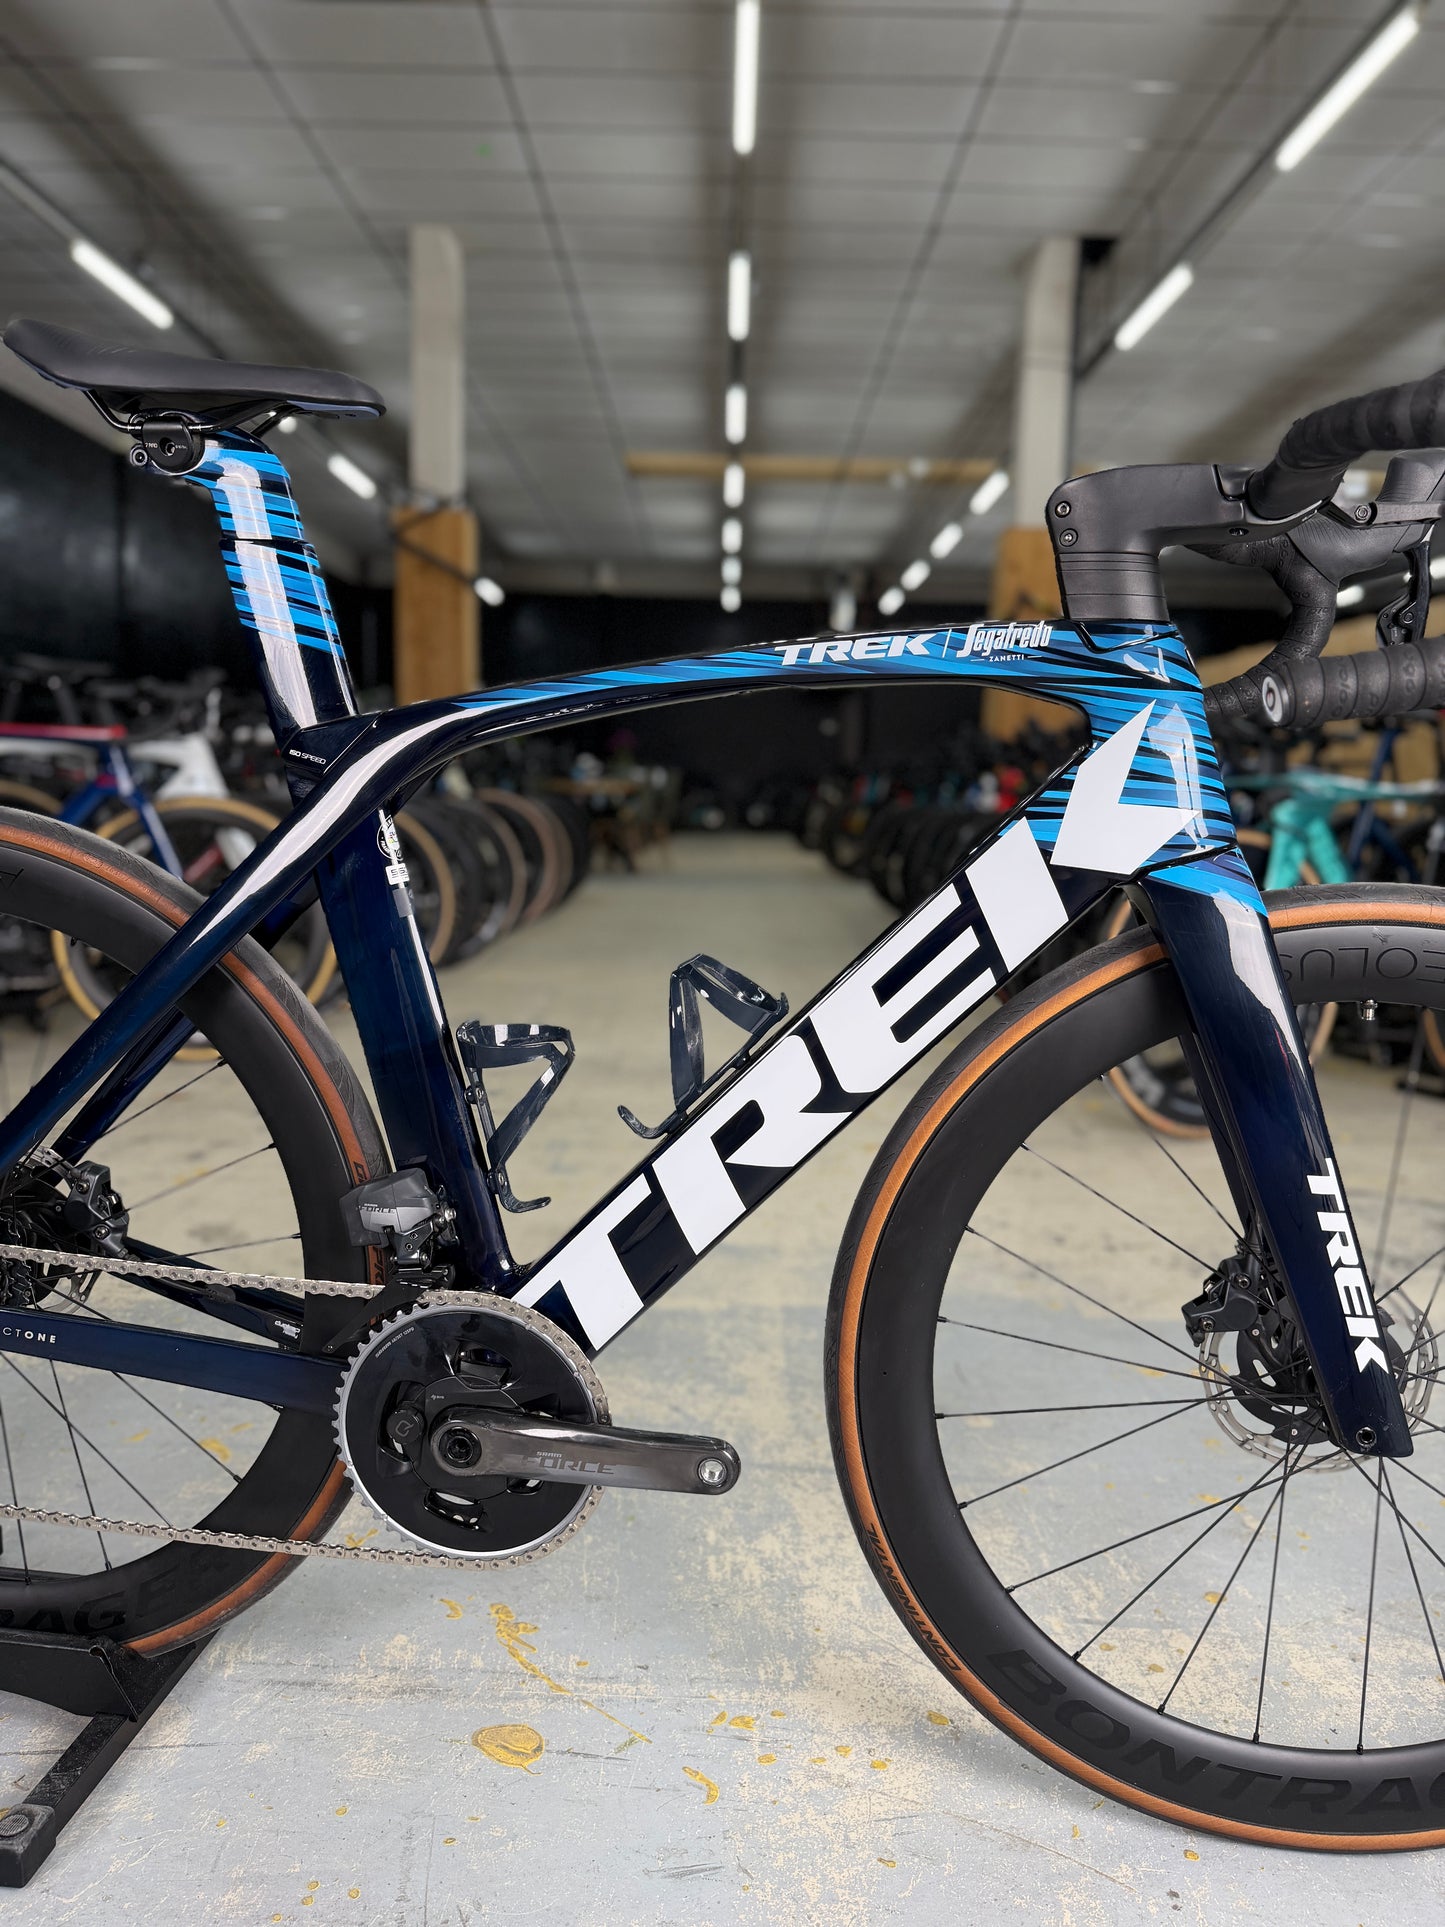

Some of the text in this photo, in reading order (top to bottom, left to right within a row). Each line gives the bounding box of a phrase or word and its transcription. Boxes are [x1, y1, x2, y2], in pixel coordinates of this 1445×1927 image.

[774, 620, 1053, 666] TREK Segafredo
[988, 653, 1025, 663] ZANETTI
[511, 700, 1200, 1351] TREK
[1306, 1157, 1389, 1374] TREK
[522, 1456, 614, 1474] FORCE
[867, 1522, 962, 1672] CONTINENTAL
